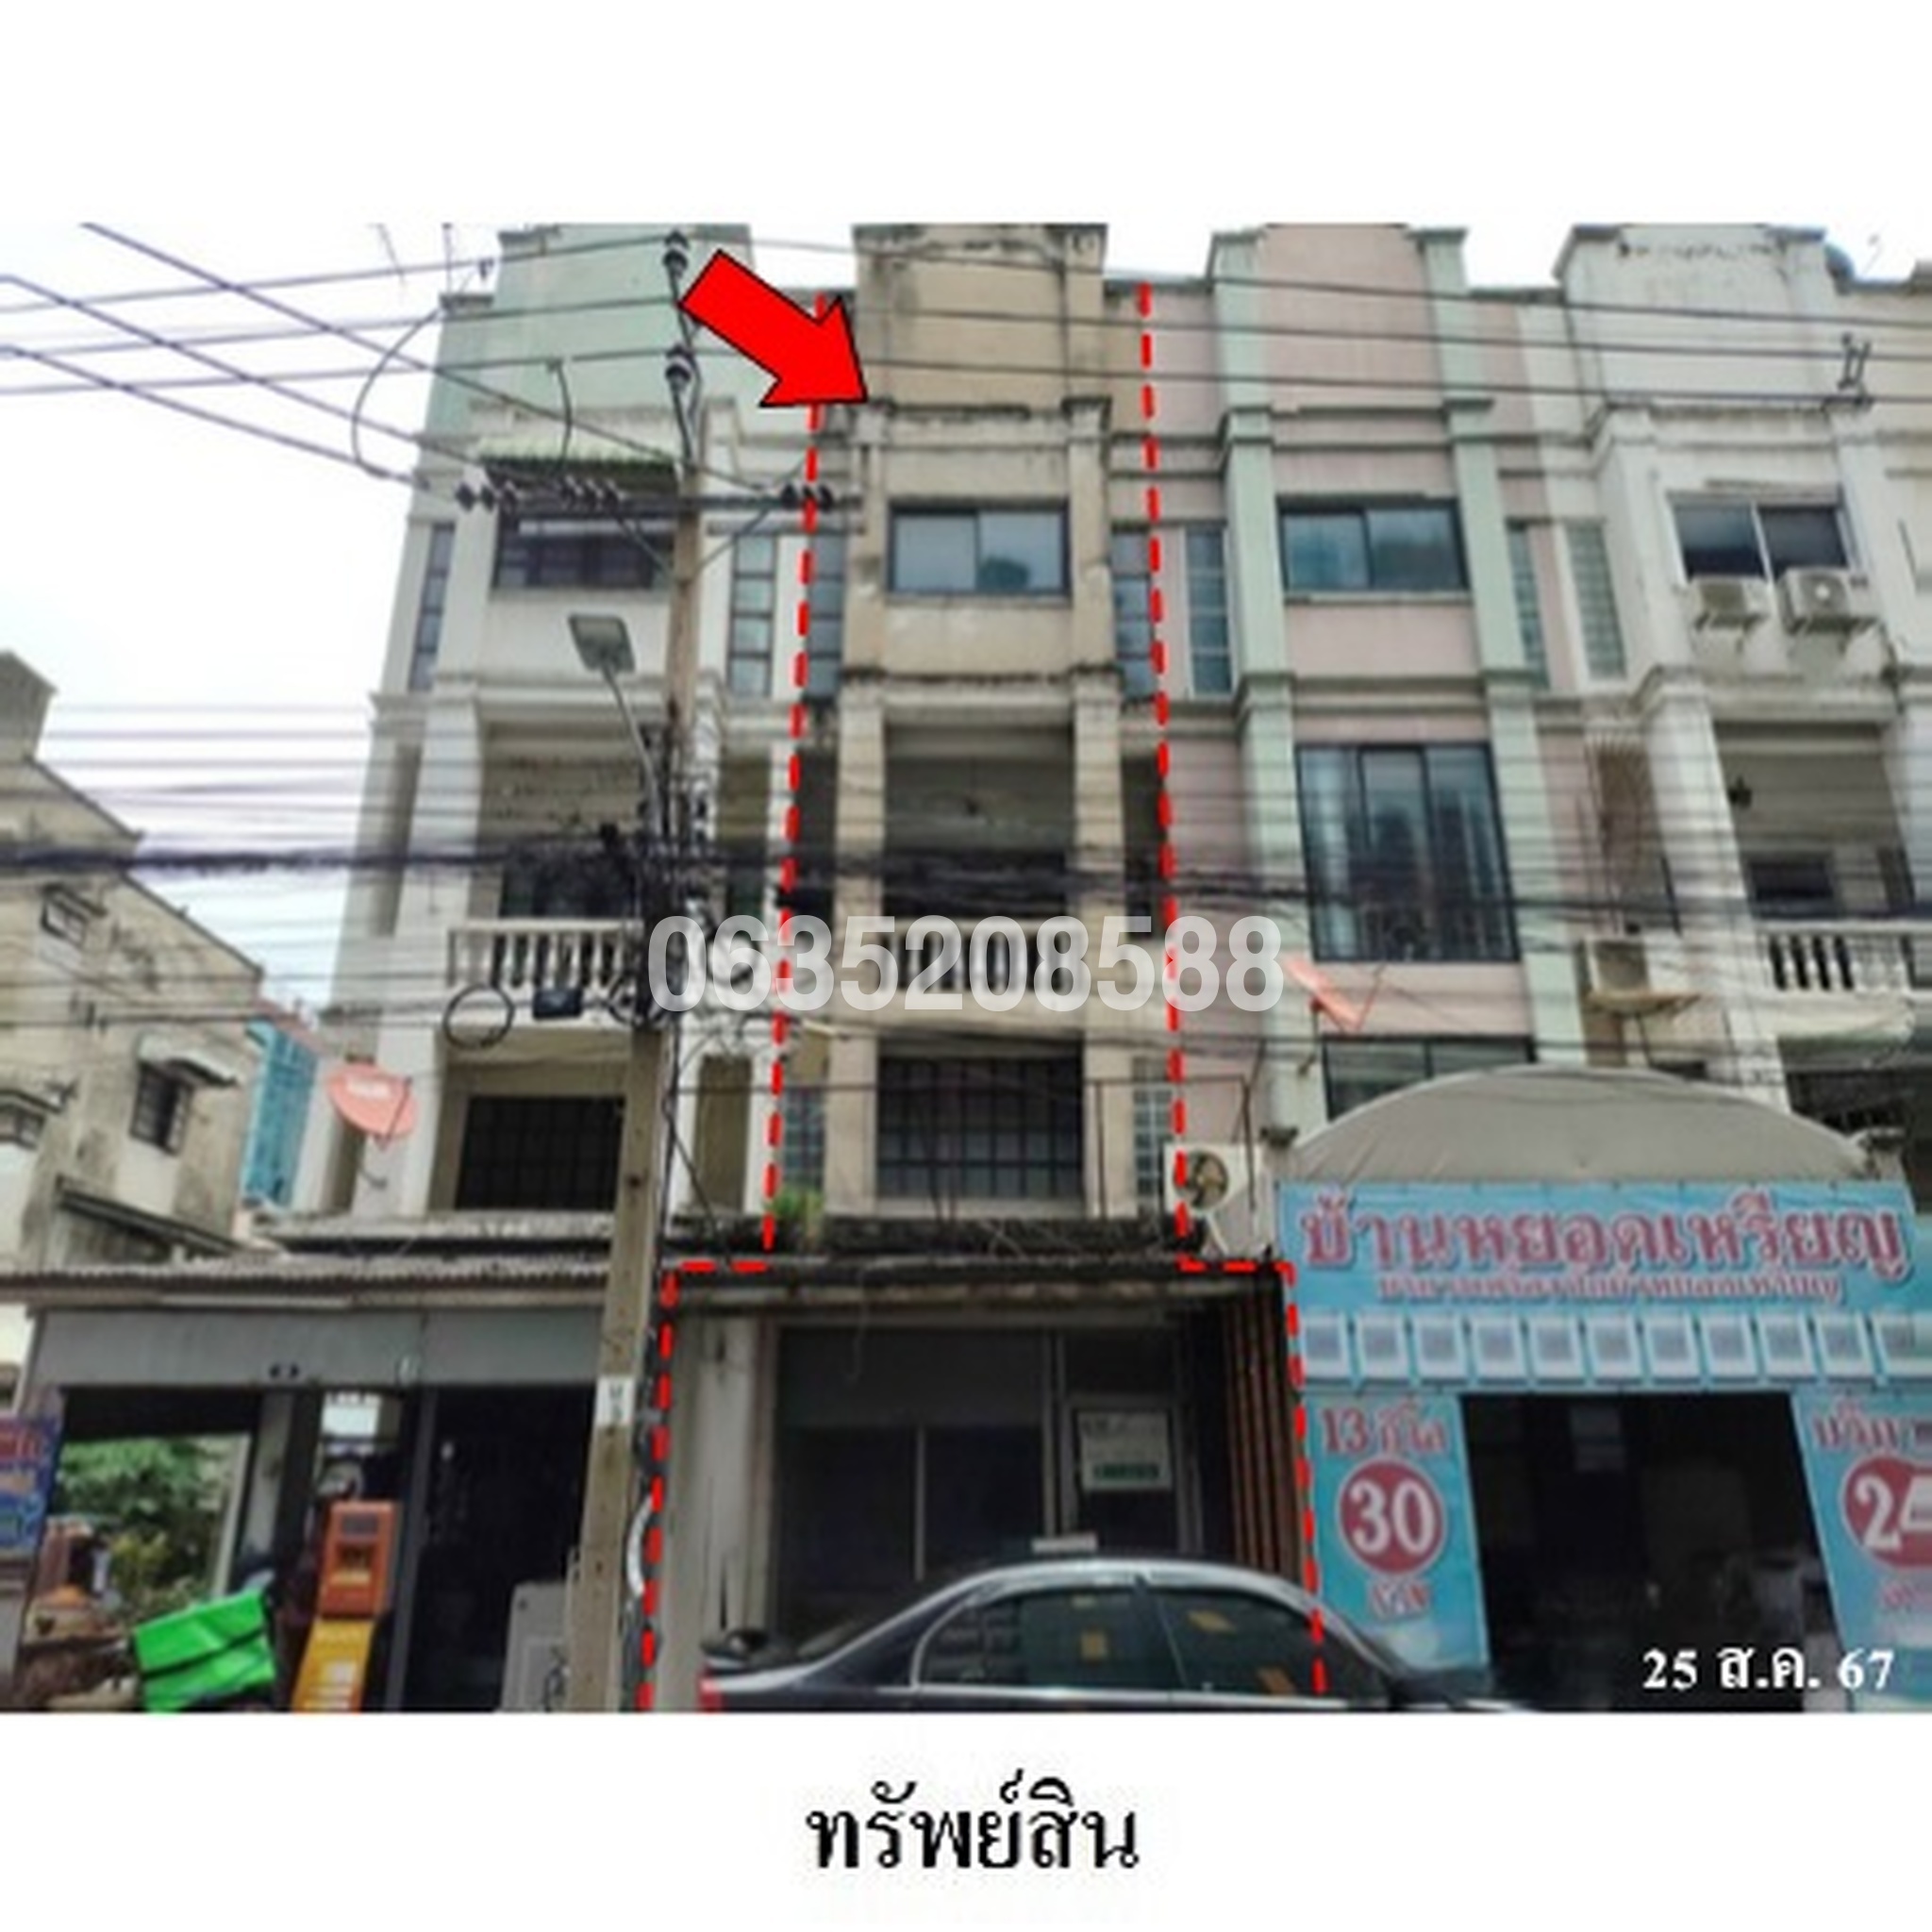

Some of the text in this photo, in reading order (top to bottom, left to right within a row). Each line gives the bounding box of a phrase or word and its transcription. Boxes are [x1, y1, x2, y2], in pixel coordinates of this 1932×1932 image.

[1299, 1189, 1907, 1278] บ้านหยอดเหรียญ
[1322, 1407, 1368, 1454] 13
[1349, 1476, 1436, 1556] 30
